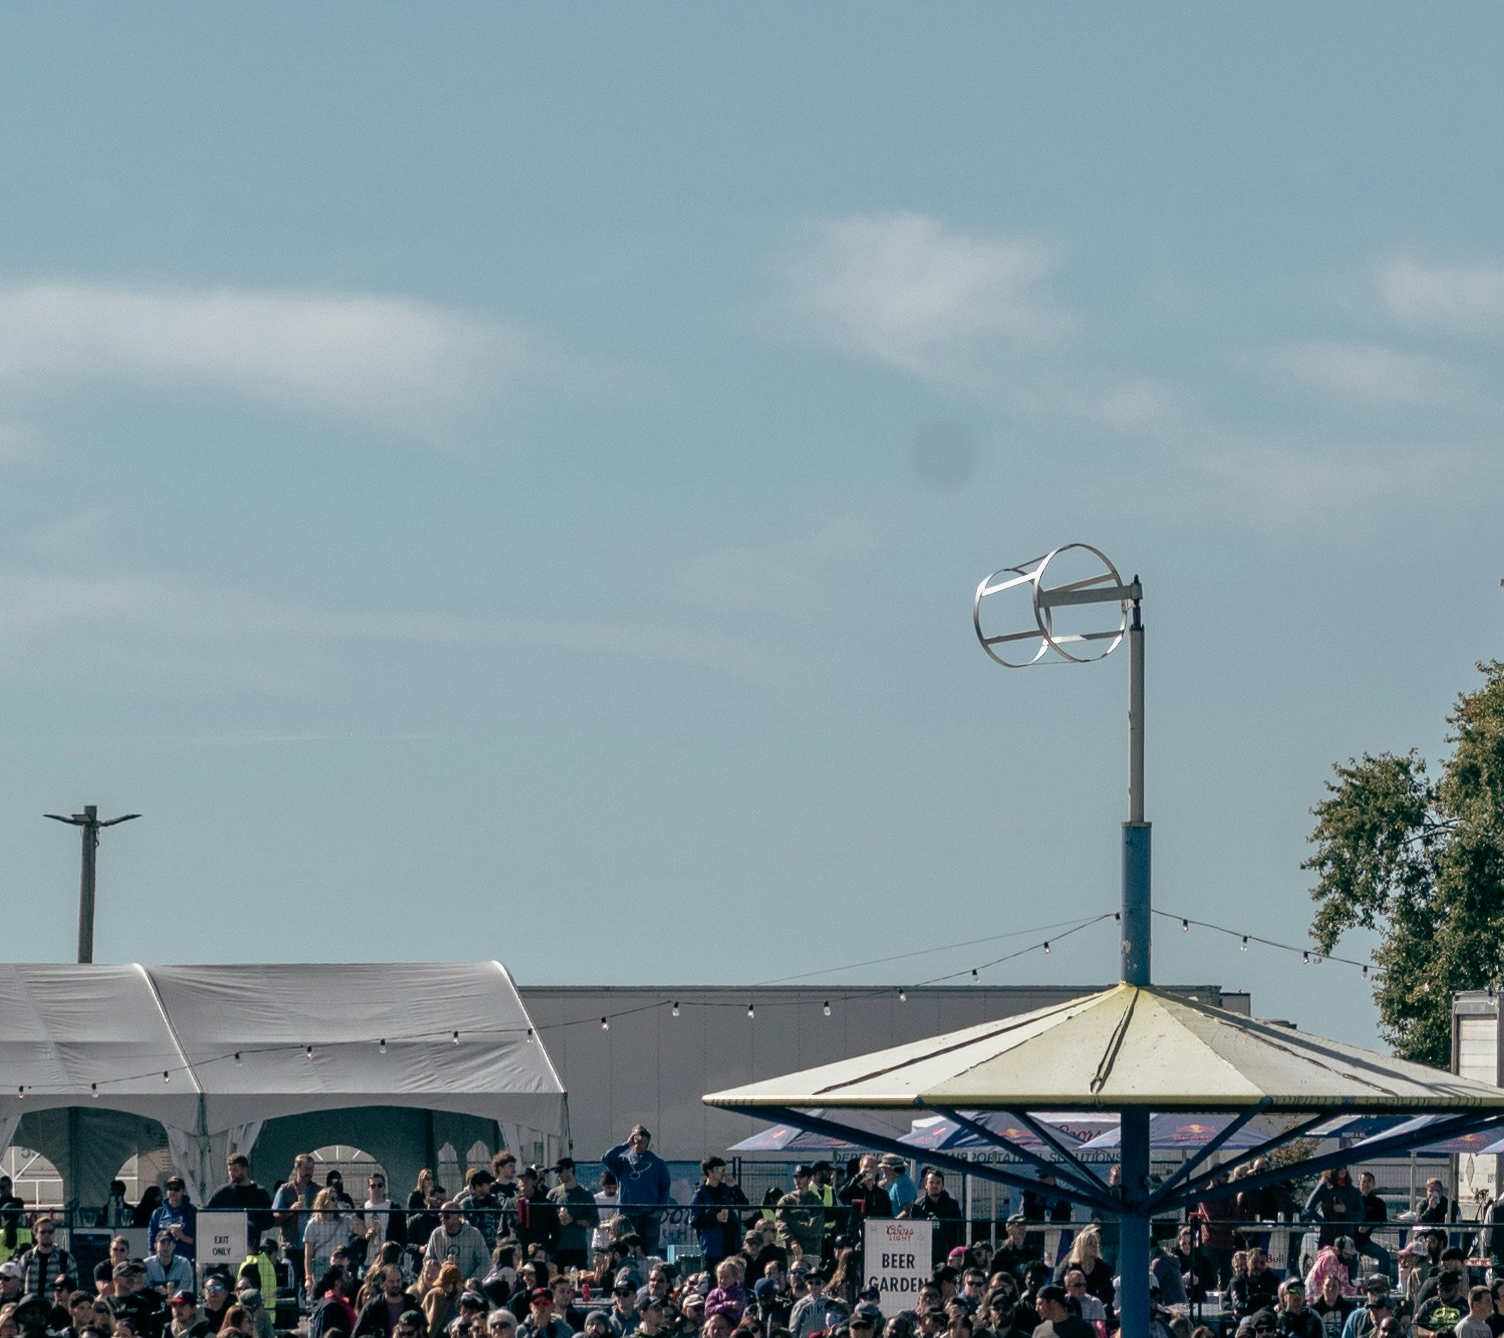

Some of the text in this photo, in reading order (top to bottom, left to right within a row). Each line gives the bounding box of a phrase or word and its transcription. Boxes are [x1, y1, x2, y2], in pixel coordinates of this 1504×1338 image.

[886, 1224, 914, 1236] Coors
[214, 1236, 229, 1244] EXIT
[212, 1247, 231, 1256] ONLY
[881, 1253, 915, 1269] BEER
[868, 1276, 928, 1293] GARDEN
